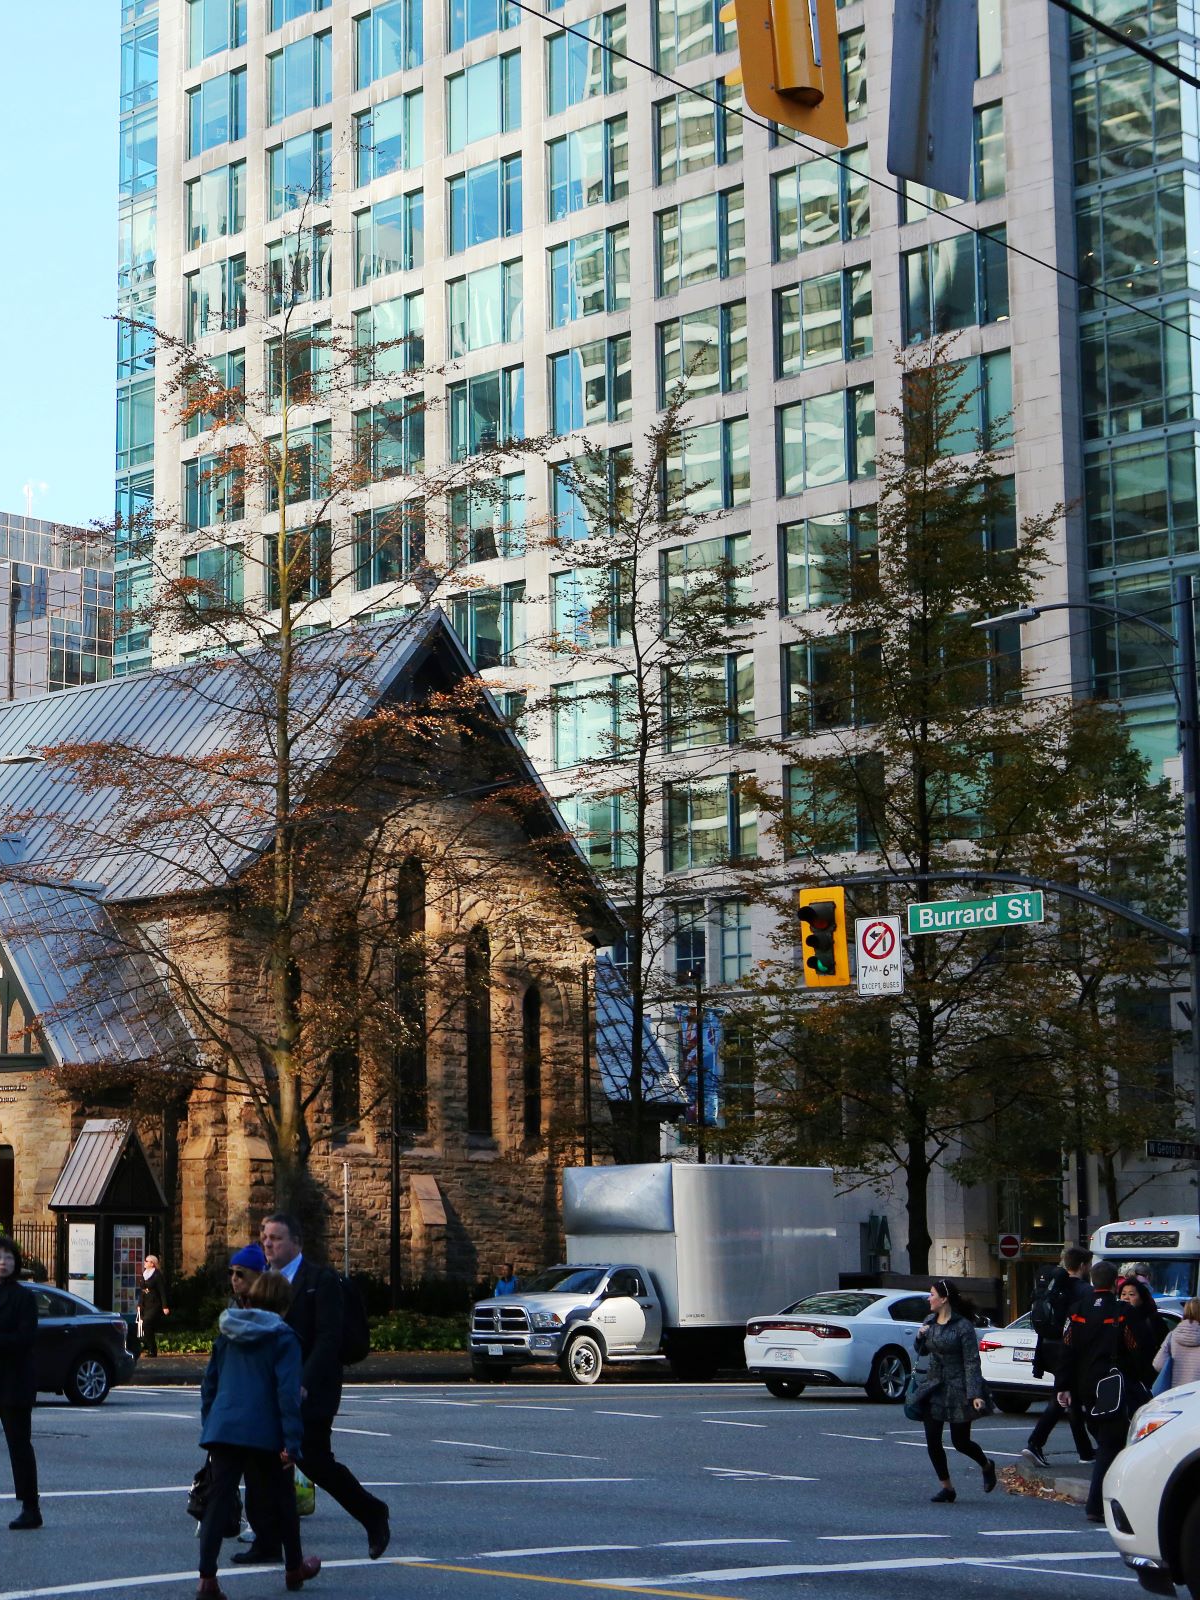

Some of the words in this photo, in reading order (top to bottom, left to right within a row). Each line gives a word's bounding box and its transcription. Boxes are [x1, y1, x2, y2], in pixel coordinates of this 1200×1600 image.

[919, 902, 997, 928] Burrard
[1007, 898, 1031, 919] St
[861, 982, 881, 990] EXCEPT
[882, 981, 900, 989] BUSES
